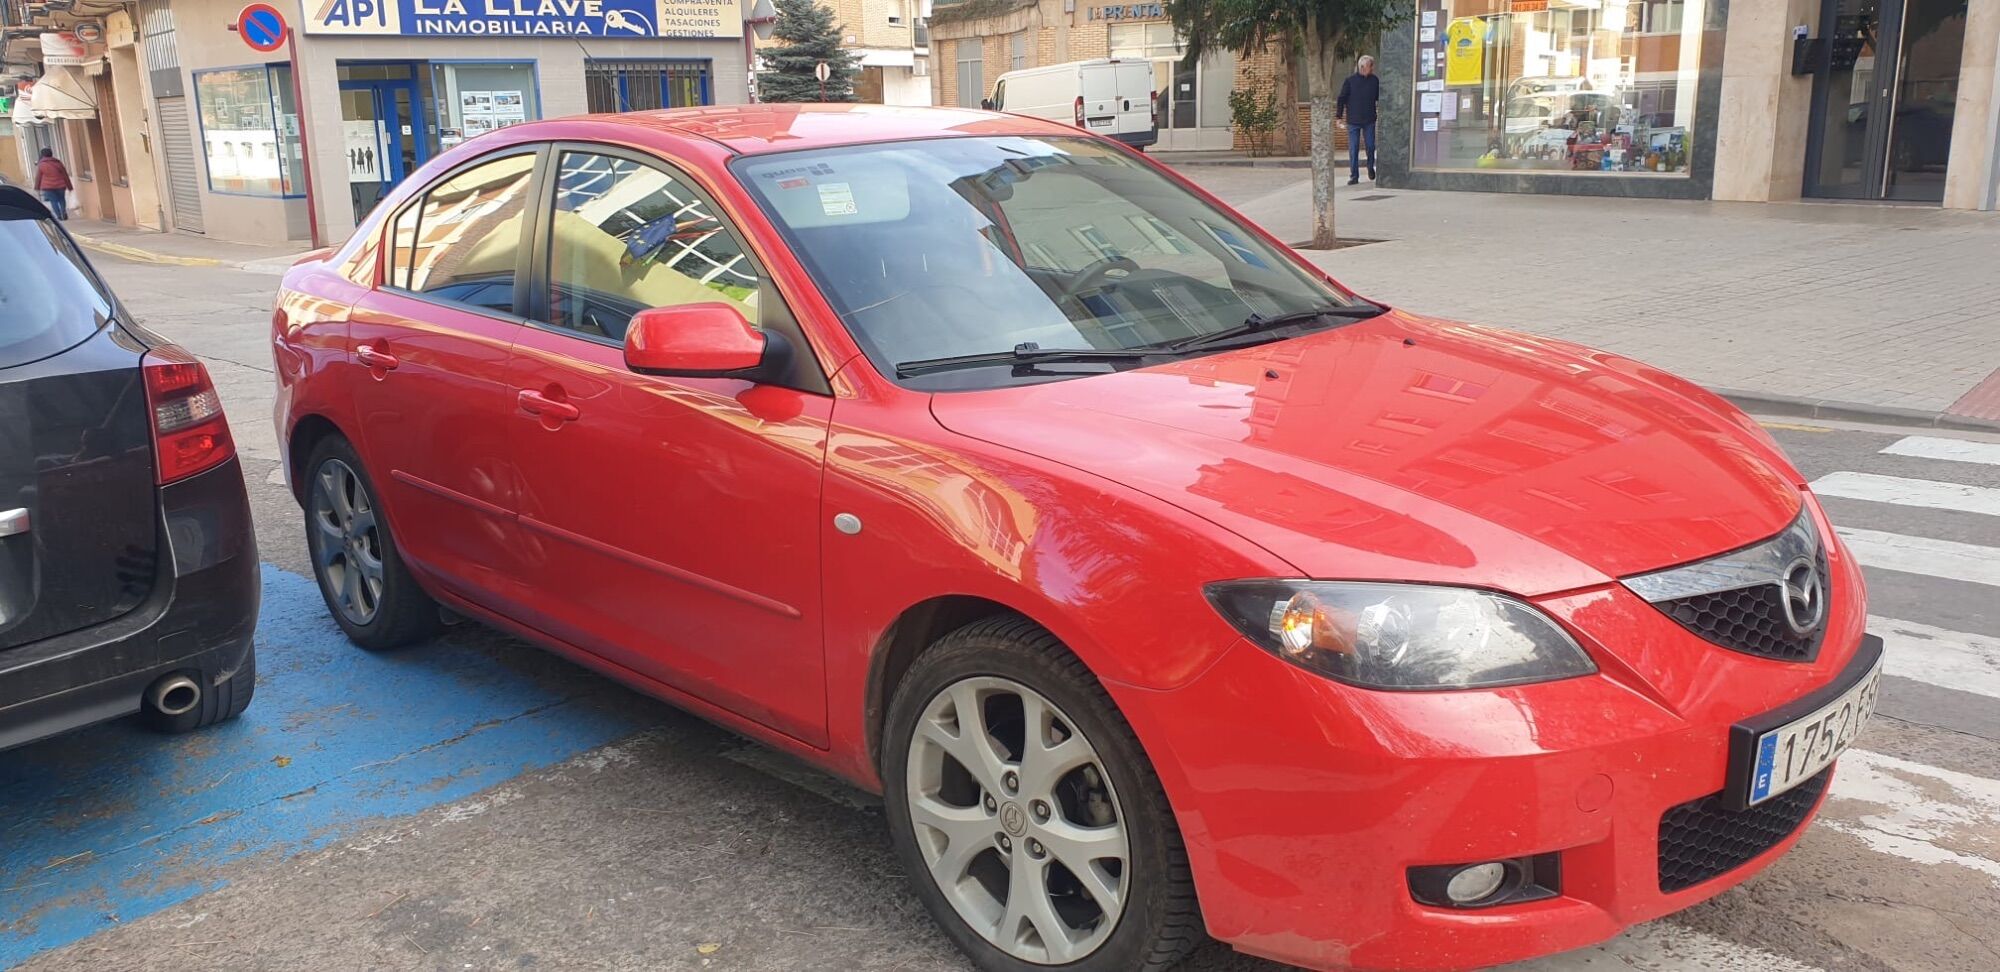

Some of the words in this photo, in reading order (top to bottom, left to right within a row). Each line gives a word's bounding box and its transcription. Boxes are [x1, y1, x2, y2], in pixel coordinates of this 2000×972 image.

[324, 0, 386, 27] API
[414, 0, 467, 15] LA
[485, 0, 603, 17] LLAVE
[665, 8, 719, 16] ALQUILERES
[416, 19, 592, 35] INMOBILIARIA
[665, 18, 721, 27] TASACIONES
[666, 29, 714, 37] GESTIONES
[1784, 702, 1850, 783] 1752
